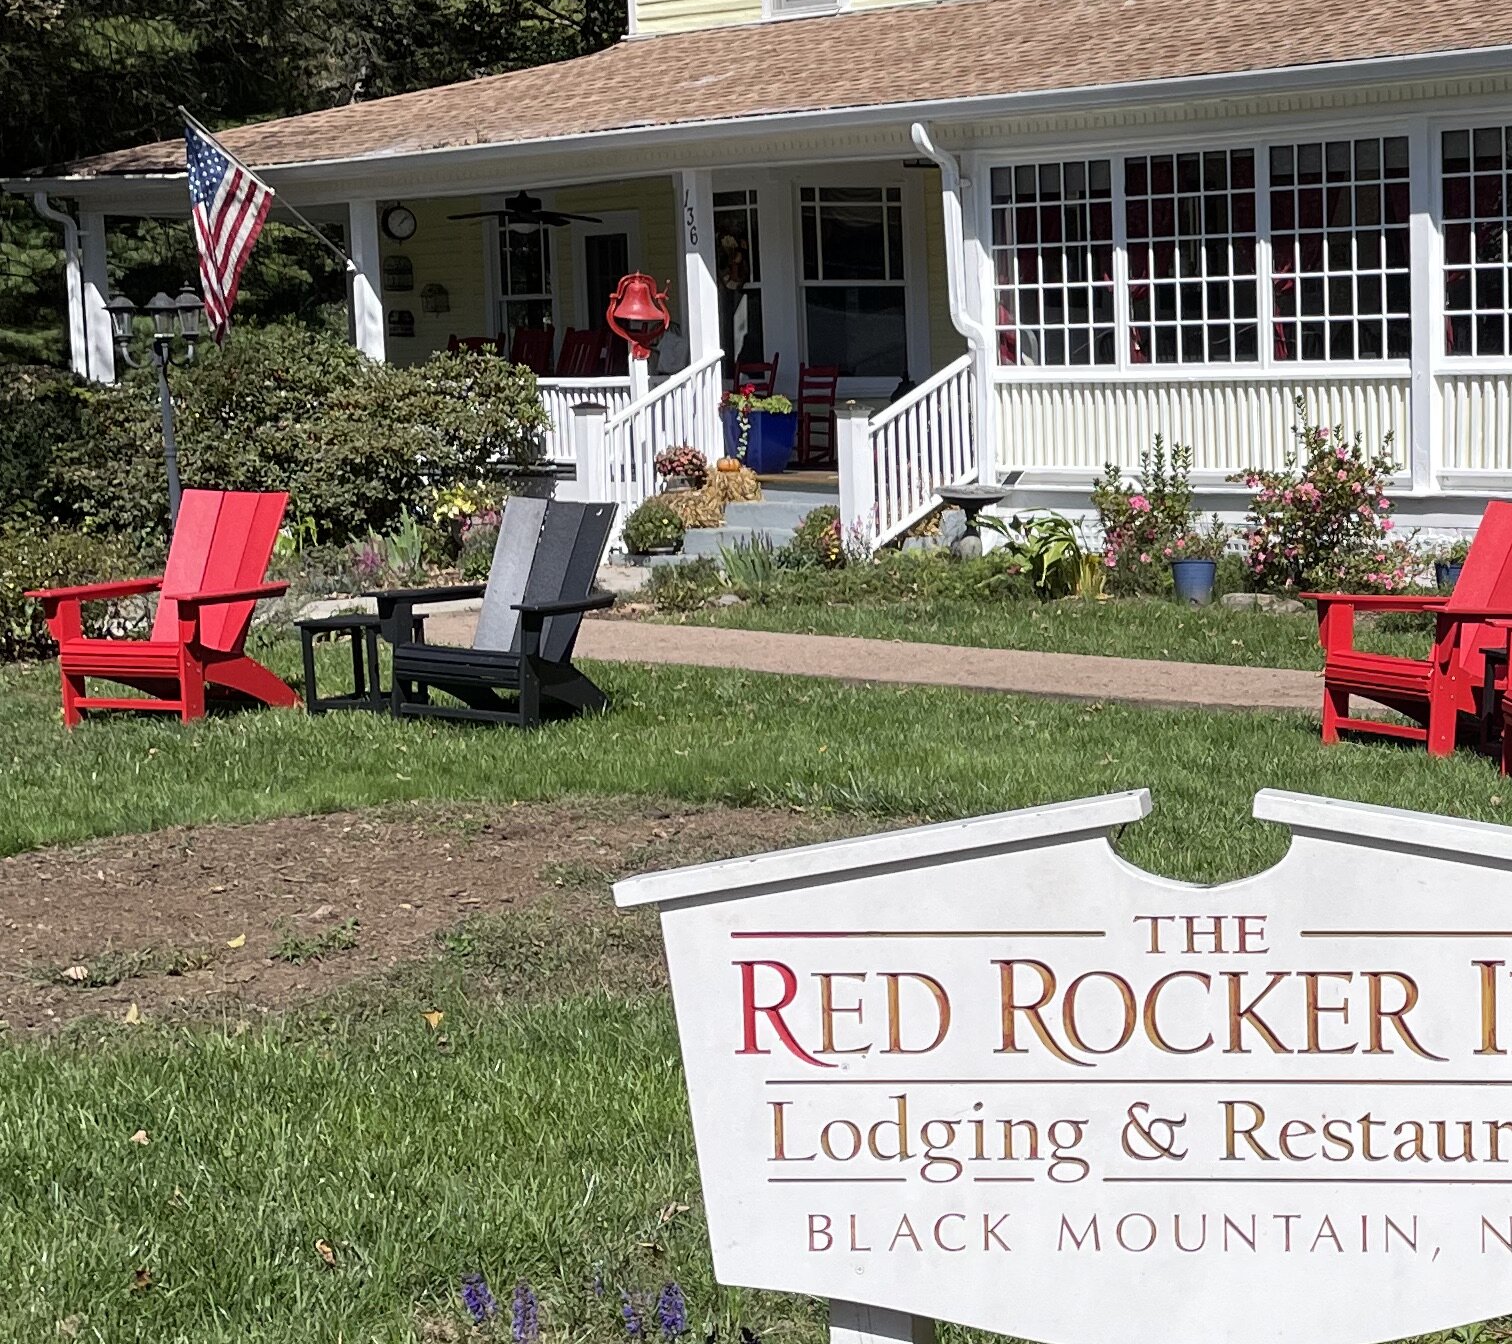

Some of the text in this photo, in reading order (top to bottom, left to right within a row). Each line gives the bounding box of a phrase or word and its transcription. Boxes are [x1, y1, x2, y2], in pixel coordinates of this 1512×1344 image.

[683, 188, 699, 245] 136
[1132, 914, 1270, 955] THE
[731, 959, 952, 1067] RED
[990, 957, 1450, 1067] ROCKER
[766, 1093, 1091, 1184] Lodging
[1121, 1100, 1189, 1162] &
[807, 1212, 1012, 1253] BLACK
[1057, 1212, 1441, 1262] MOUNTAIN,
